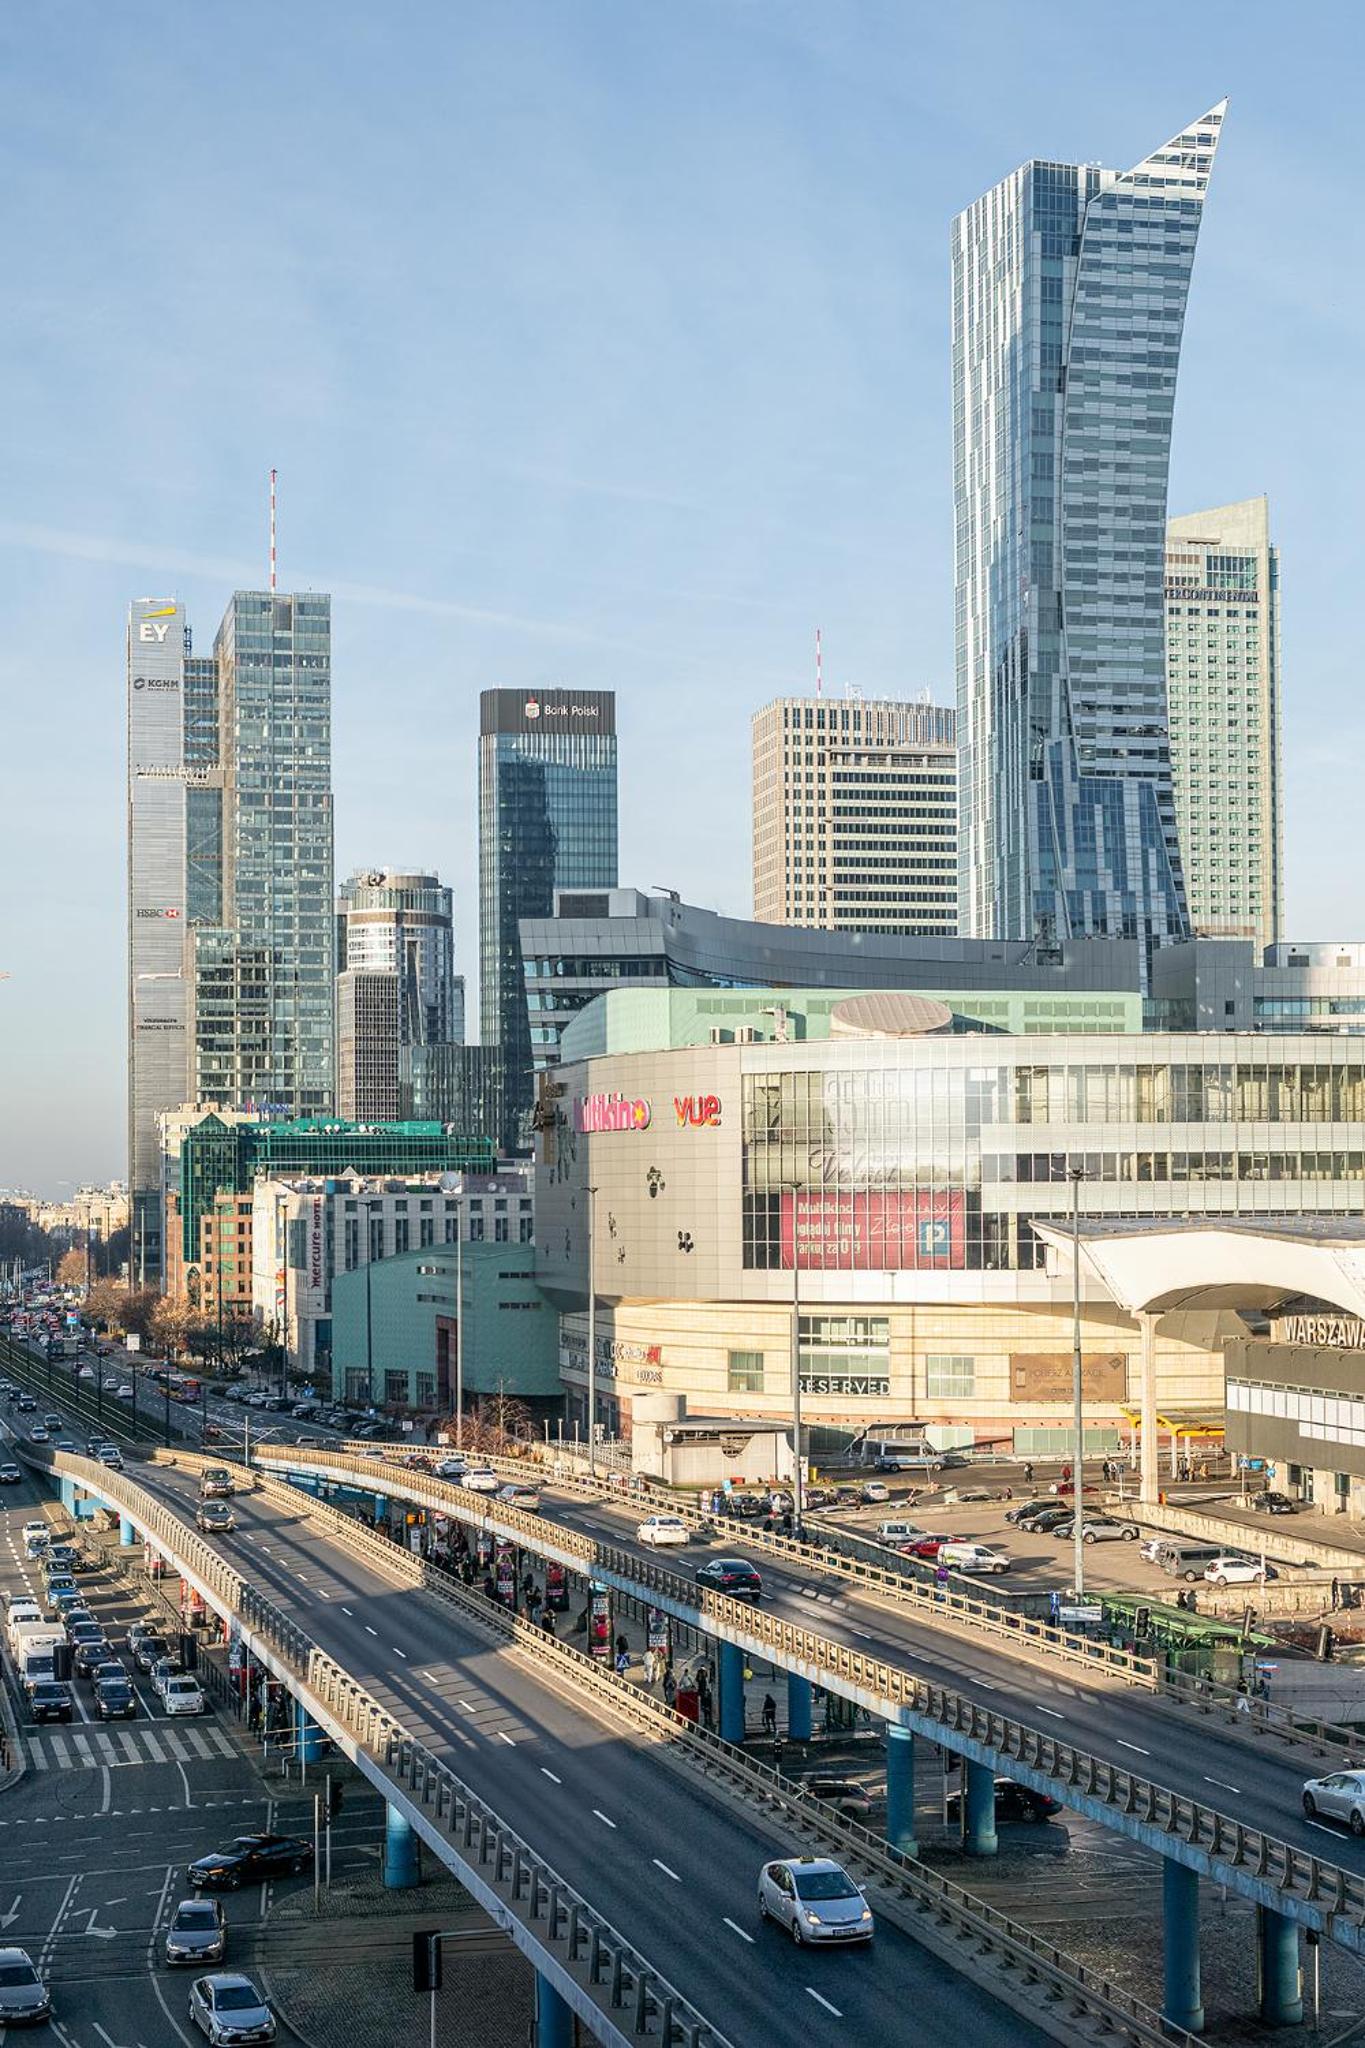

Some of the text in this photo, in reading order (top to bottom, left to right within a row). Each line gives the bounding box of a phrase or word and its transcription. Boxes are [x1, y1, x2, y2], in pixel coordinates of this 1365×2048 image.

[140, 624, 170, 642] EY
[148, 680, 179, 688] KGHM
[544, 704, 599, 716] Bank Polski
[137, 909, 163, 918] HSBC
[313, 1196, 322, 1230] HOTEL
[799, 1380, 891, 1395] RESERVED
